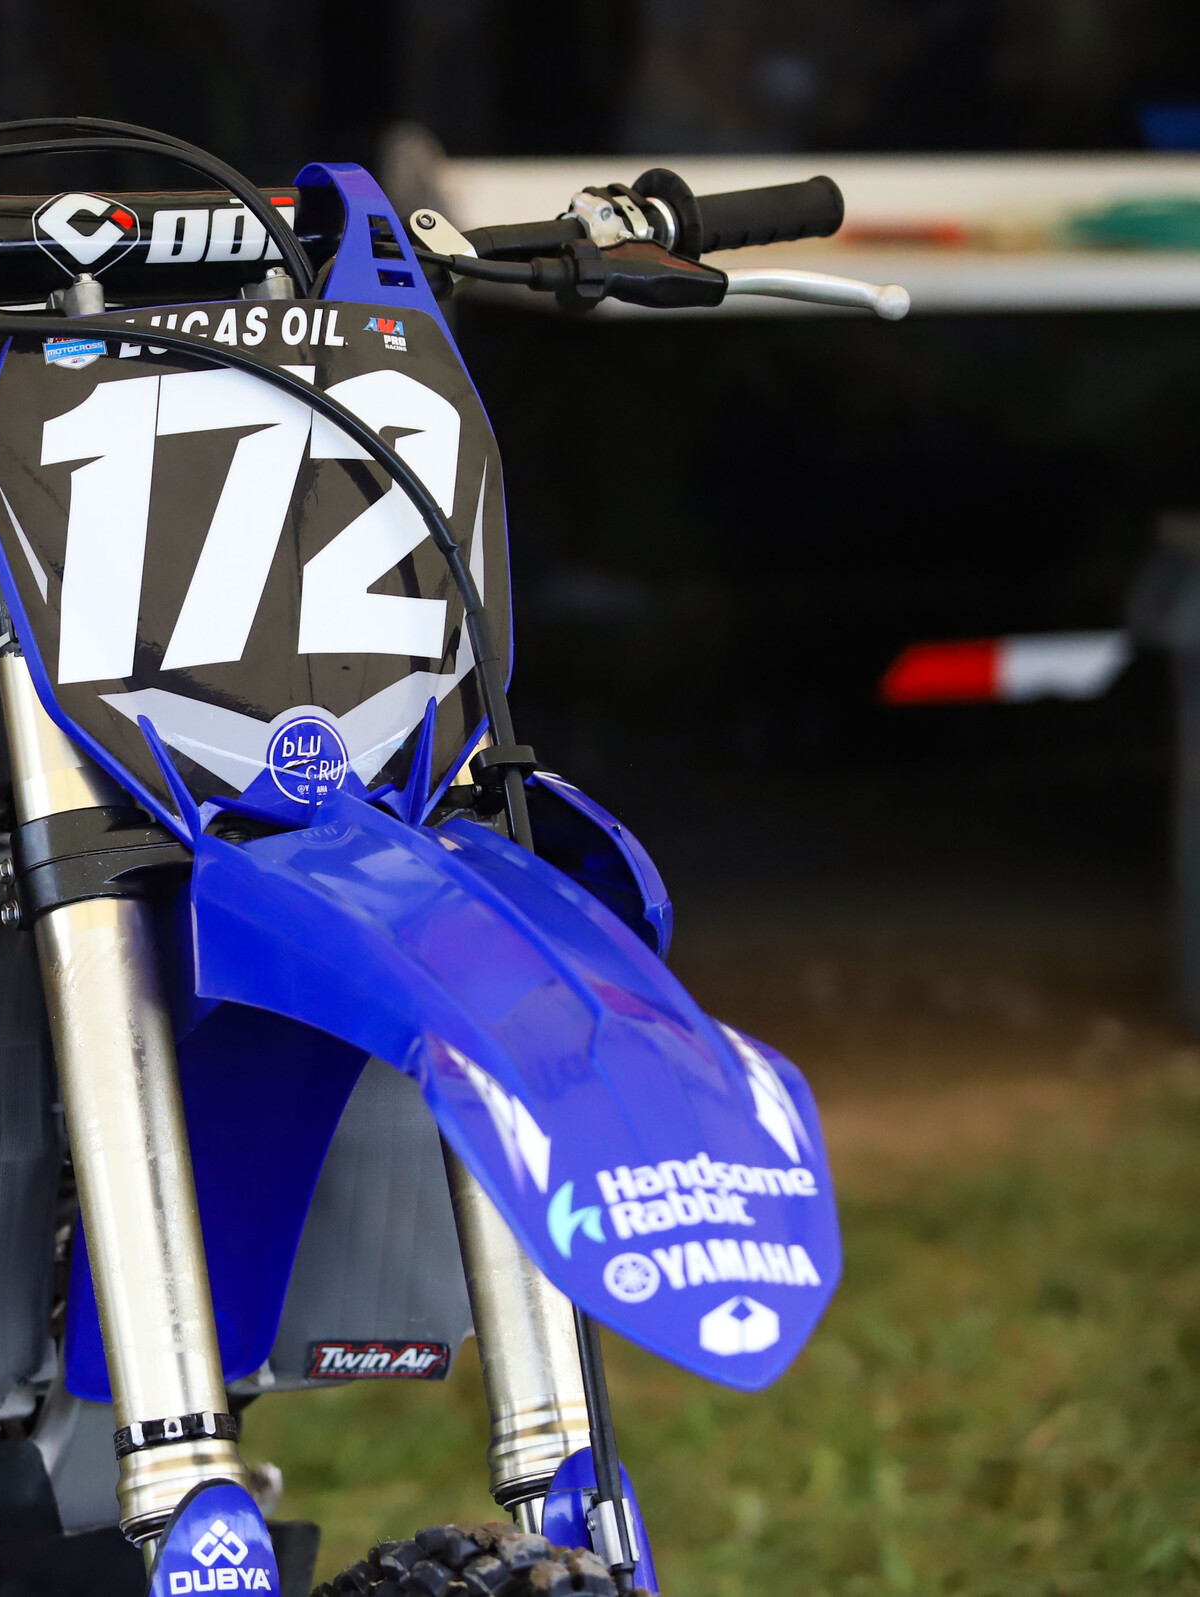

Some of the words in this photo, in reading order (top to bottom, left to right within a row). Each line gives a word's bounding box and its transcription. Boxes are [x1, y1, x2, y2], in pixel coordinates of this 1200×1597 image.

[281, 306, 345, 346] OIL
[363, 316, 405, 336] AMA
[383, 334, 407, 347] PRO
[46, 341, 104, 357] MOTOCROSS
[40, 365, 461, 685] 172
[596, 1151, 818, 1204] Handsome
[608, 1187, 756, 1240] Rabbit
[653, 1239, 821, 1290] YAMAHA
[320, 1346, 392, 1369] Twin
[390, 1347, 442, 1369] Air
[169, 1567, 272, 1595] DUBYA
